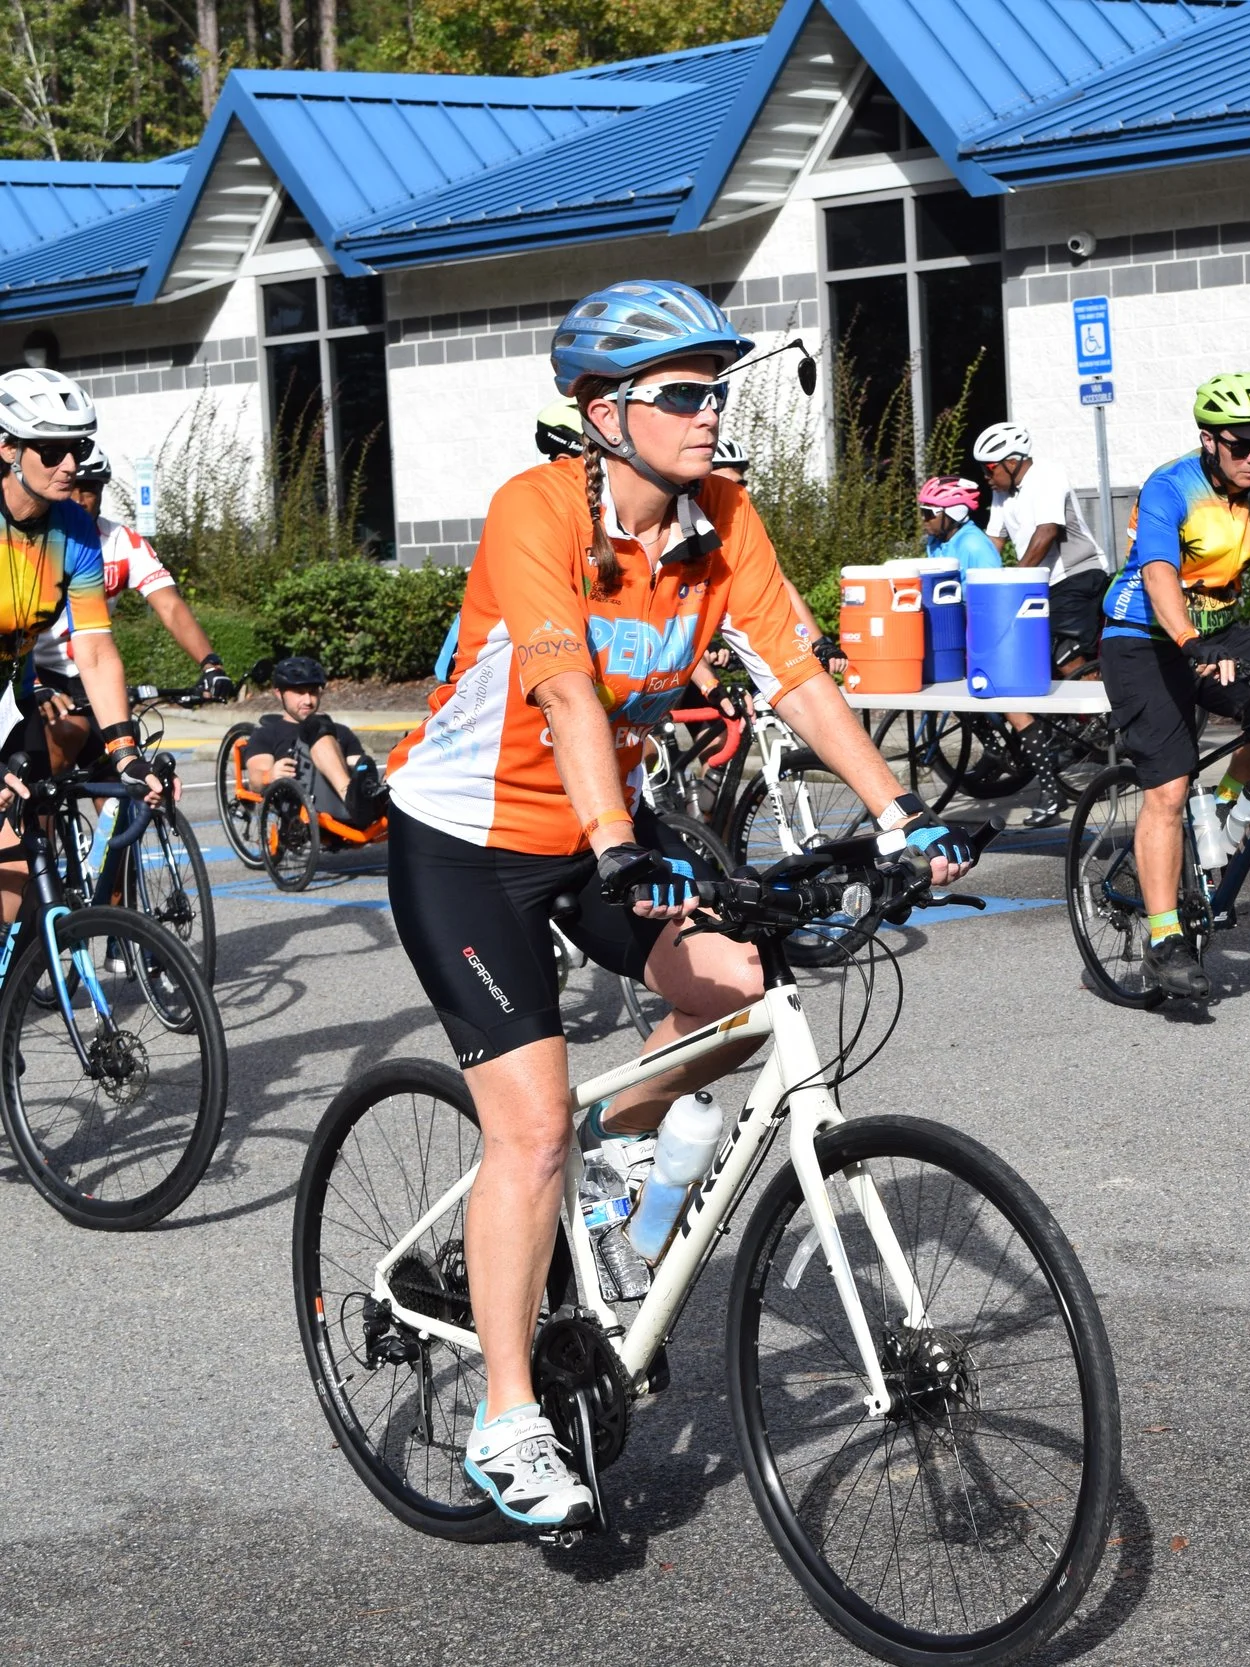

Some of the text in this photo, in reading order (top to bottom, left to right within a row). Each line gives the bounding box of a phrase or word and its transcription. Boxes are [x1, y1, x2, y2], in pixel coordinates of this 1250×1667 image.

[517, 639, 584, 667] Drayer
[648, 672, 680, 690] For A
[468, 954, 515, 1014] GARNEAU
[680, 1098, 755, 1240] TREK
